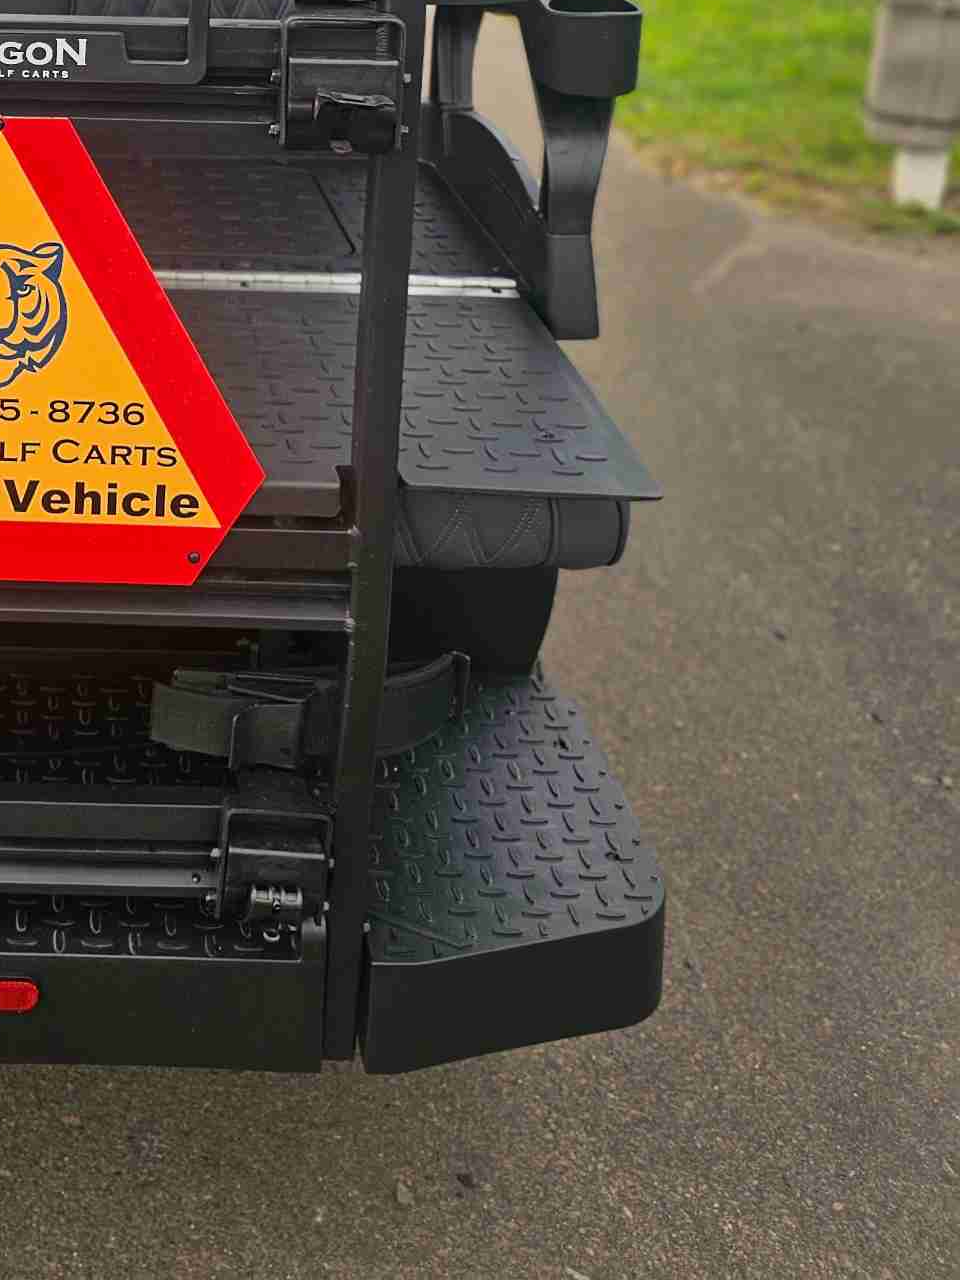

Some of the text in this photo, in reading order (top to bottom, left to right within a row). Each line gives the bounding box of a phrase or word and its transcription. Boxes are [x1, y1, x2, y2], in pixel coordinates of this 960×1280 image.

[21, 68, 71, 81] CARTS
[52, 438, 178, 468] CARTS
[3, 478, 201, 519] Vehicle
